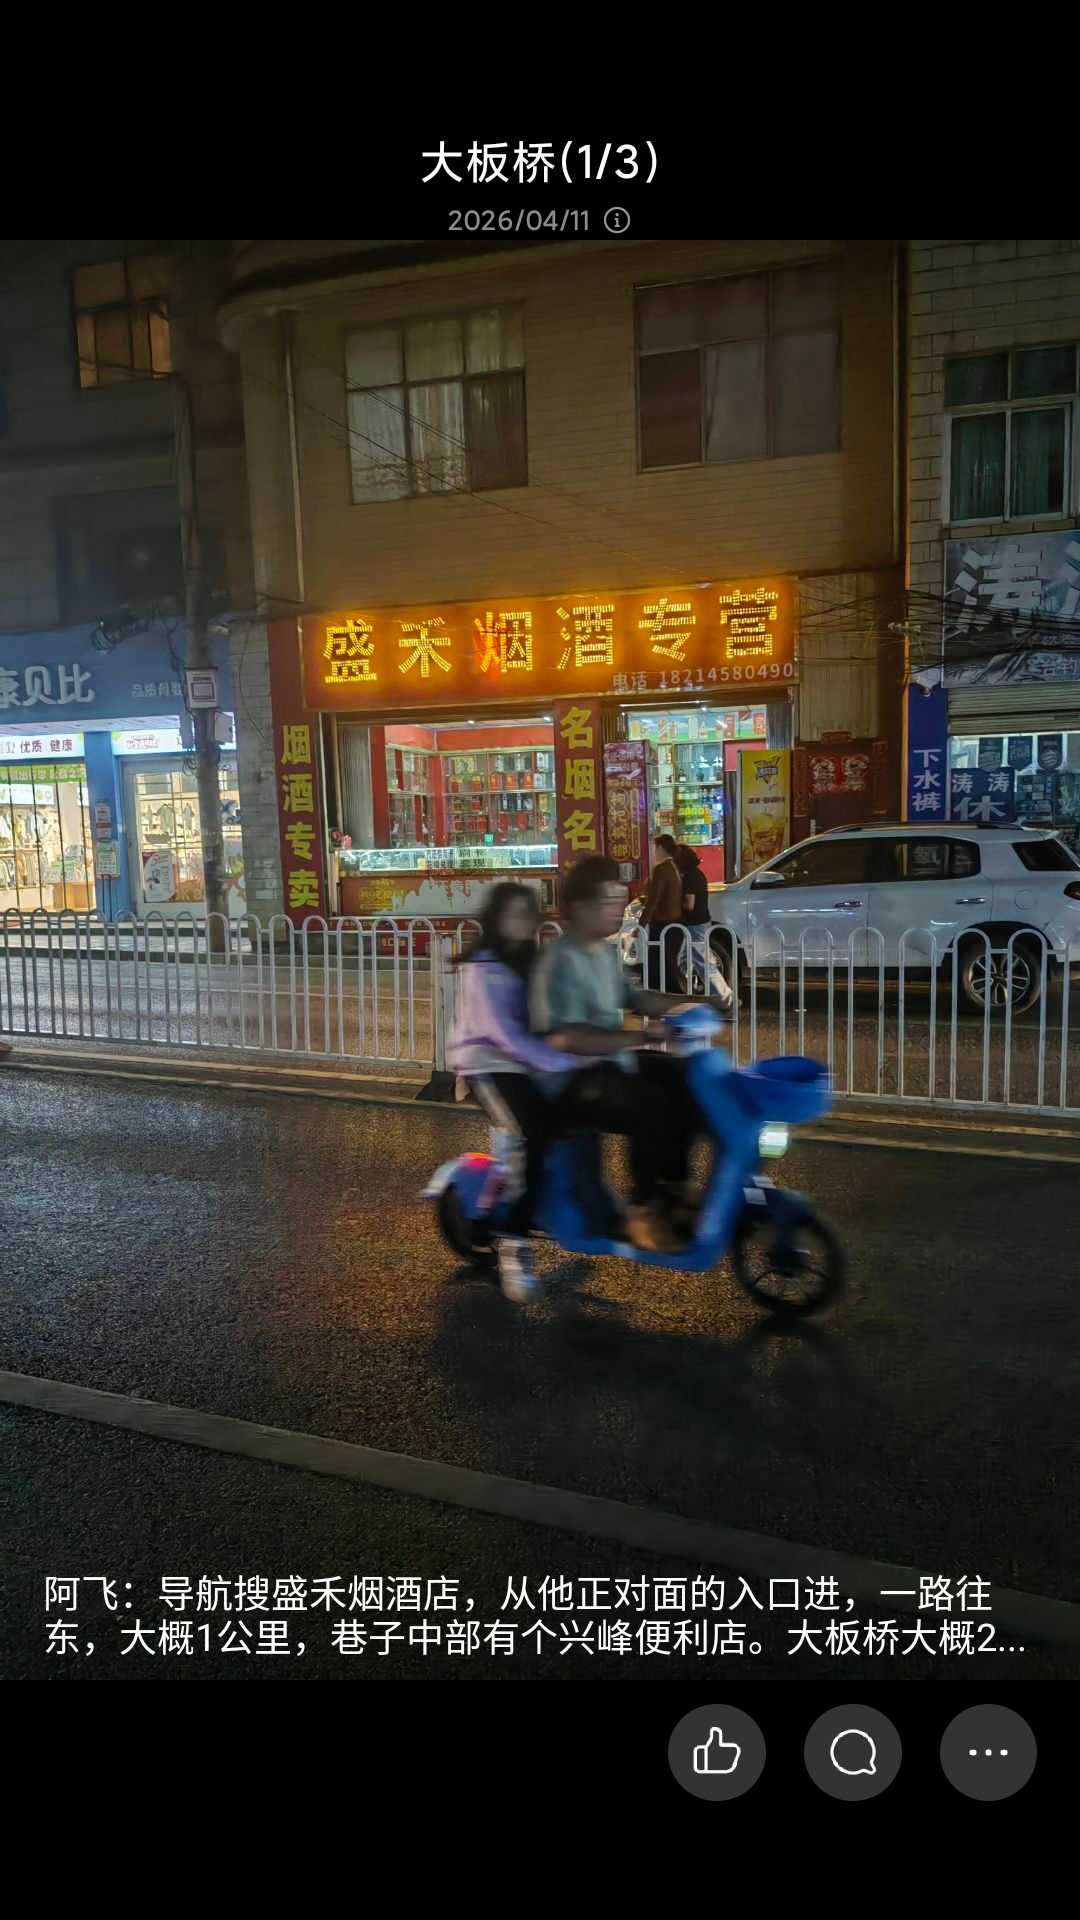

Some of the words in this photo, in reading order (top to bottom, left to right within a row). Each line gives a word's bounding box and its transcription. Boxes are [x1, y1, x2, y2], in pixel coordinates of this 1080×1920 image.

[323, 587, 780, 684] 盛禾烟酒专营
[612, 671, 648, 691] 电话
[660, 662, 793, 687] 18214580490
[19, 740, 43, 753] 优质
[49, 738, 73, 752] 健康
[911, 748, 943, 813] 下水裤
[280, 724, 321, 909] 烟酒专卖
[560, 706, 598, 868] 名烟名
